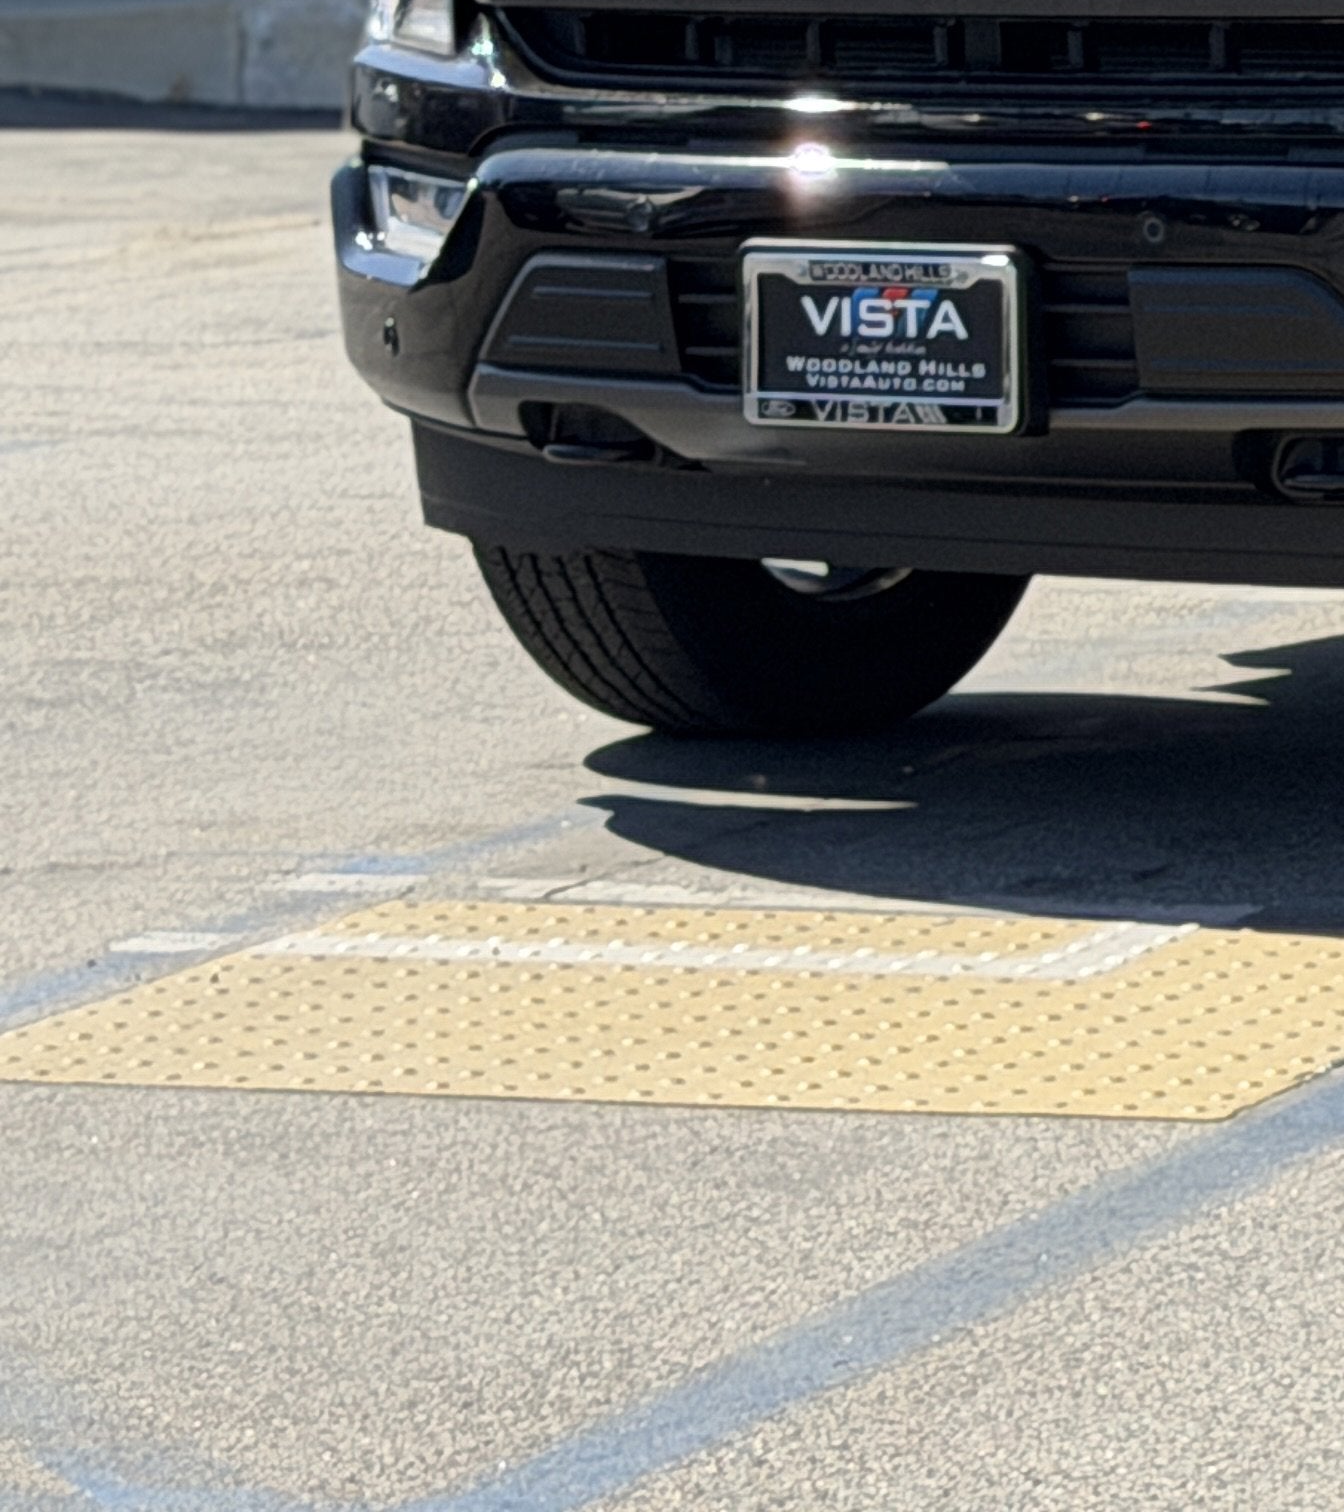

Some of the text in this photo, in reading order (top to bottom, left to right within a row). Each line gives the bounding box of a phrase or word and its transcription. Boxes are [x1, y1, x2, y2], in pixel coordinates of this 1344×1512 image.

[800, 295, 968, 340] VISTA
[786, 355, 986, 379] WOODLAND HILLS
[811, 400, 916, 425] VISTA
